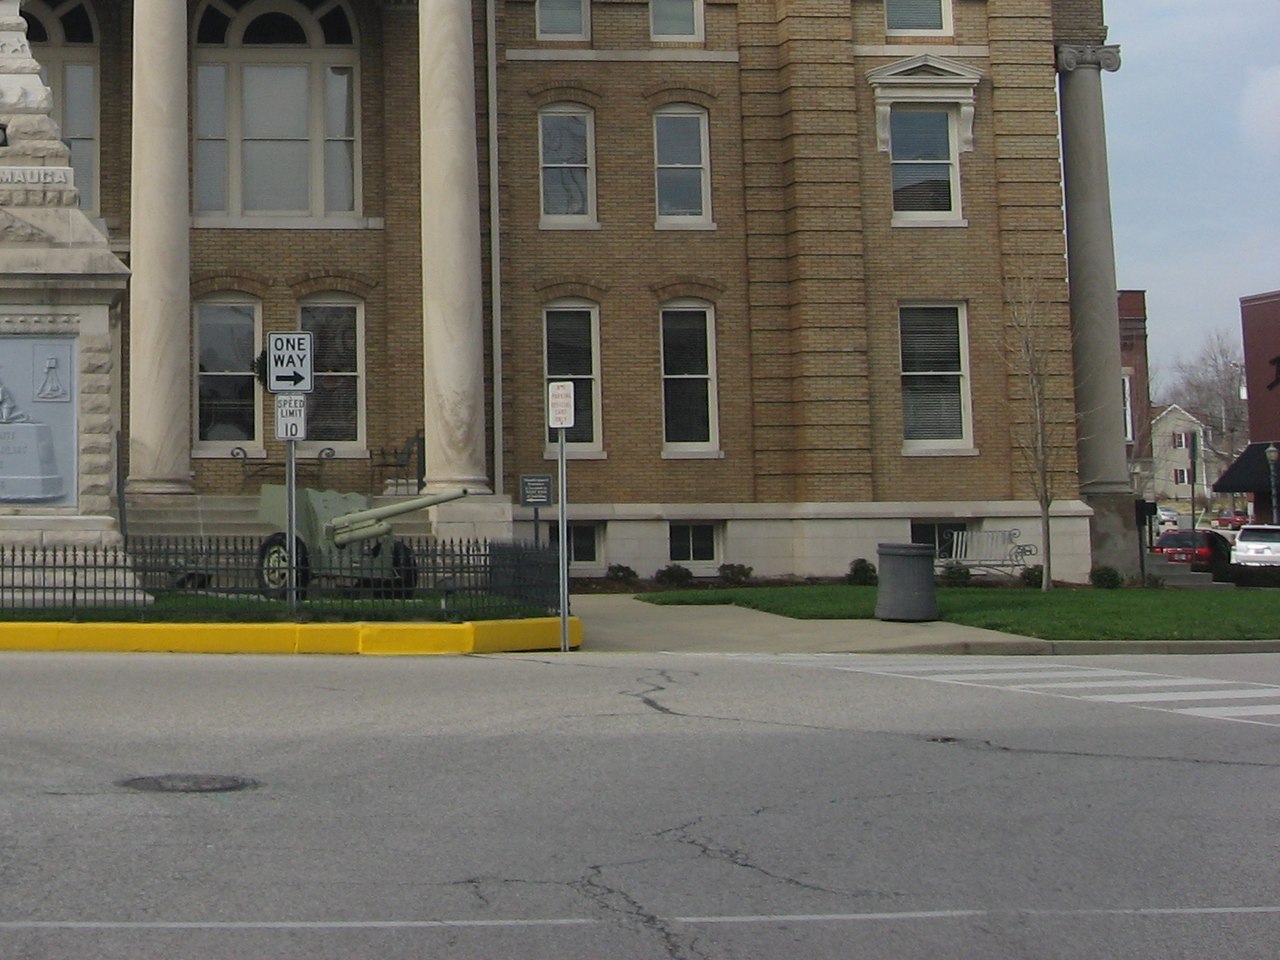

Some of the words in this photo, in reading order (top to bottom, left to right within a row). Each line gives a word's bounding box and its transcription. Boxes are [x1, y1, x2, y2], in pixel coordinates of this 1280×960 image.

[274, 337, 306, 351] ONE
[273, 354, 307, 368] WAY
[277, 399, 305, 409] SPEED
[280, 409, 303, 418] LIMIT
[285, 423, 298, 437] 10
